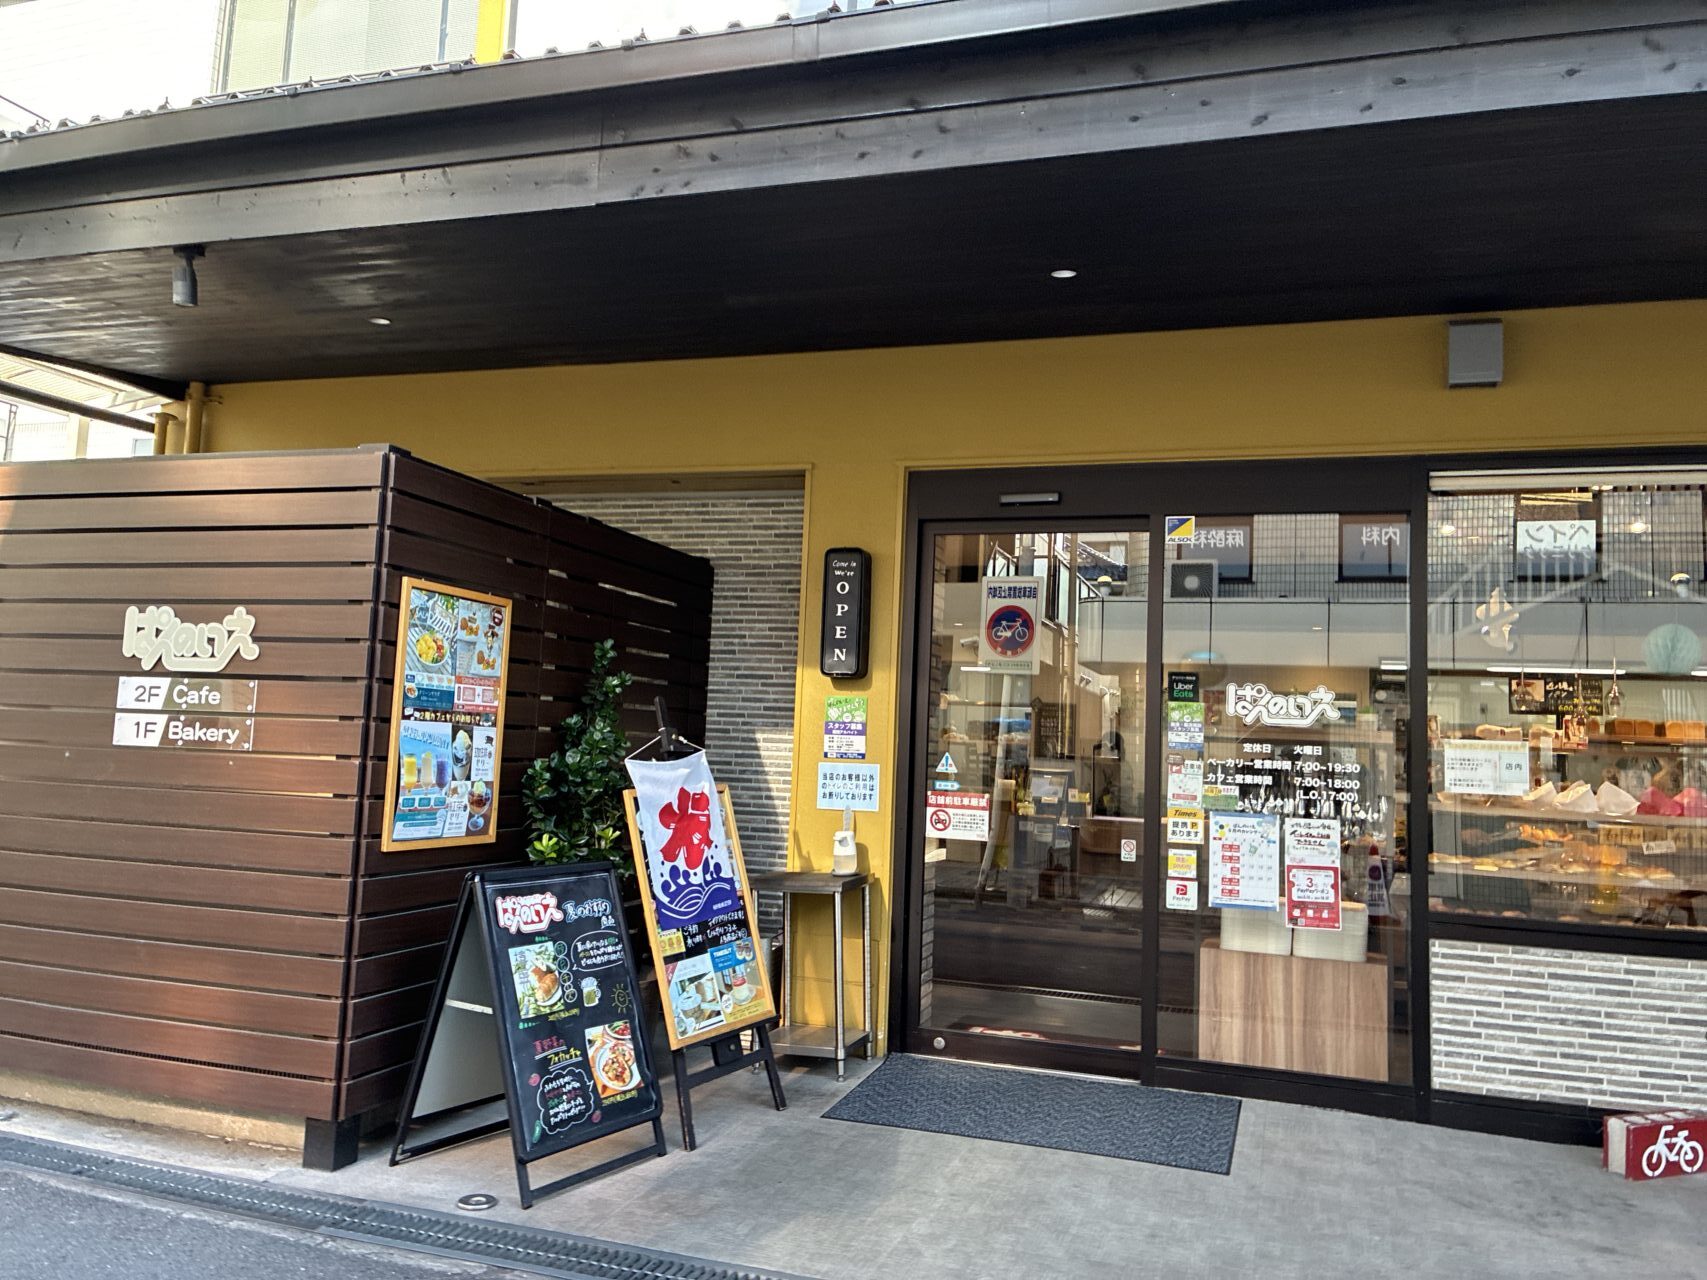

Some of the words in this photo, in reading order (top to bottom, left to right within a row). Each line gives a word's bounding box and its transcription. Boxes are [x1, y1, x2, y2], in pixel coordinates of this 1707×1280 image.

[833, 581, 850, 661] OPEN
[122, 606, 260, 672] ぱんのいえ
[1173, 682, 1194, 690] Uber
[134, 685, 162, 703] 2F
[173, 685, 221, 705] Cafe
[1173, 690, 1194, 698] Eats
[1226, 683, 1341, 728] ぱんのいえ
[134, 721, 158, 739] 1F
[168, 721, 240, 744] Bakery
[1243, 743, 1272, 753] 定休日
[1293, 745, 1322, 756] 火曜日
[1206, 758, 1292, 770] ベーカリー営業時間
[1505, 763, 1522, 771] 店内
[822, 772, 875, 782] 当店のお客様以外
[1206, 772, 1272, 785] カフェ営業時間
[821, 782, 875, 791] のトイレのご利用は
[821, 791, 874, 801] お断りしております
[928, 795, 988, 807] 店舗前駐車厳禁
[1295, 790, 1358, 802] (L.O.17:00)
[1173, 809, 1197, 817] Times
[658, 787, 714, 871] 氷
[1172, 821, 1188, 829] 提携
[1306, 877, 1314, 888] 3
[496, 892, 564, 934] ぱんのいえ
